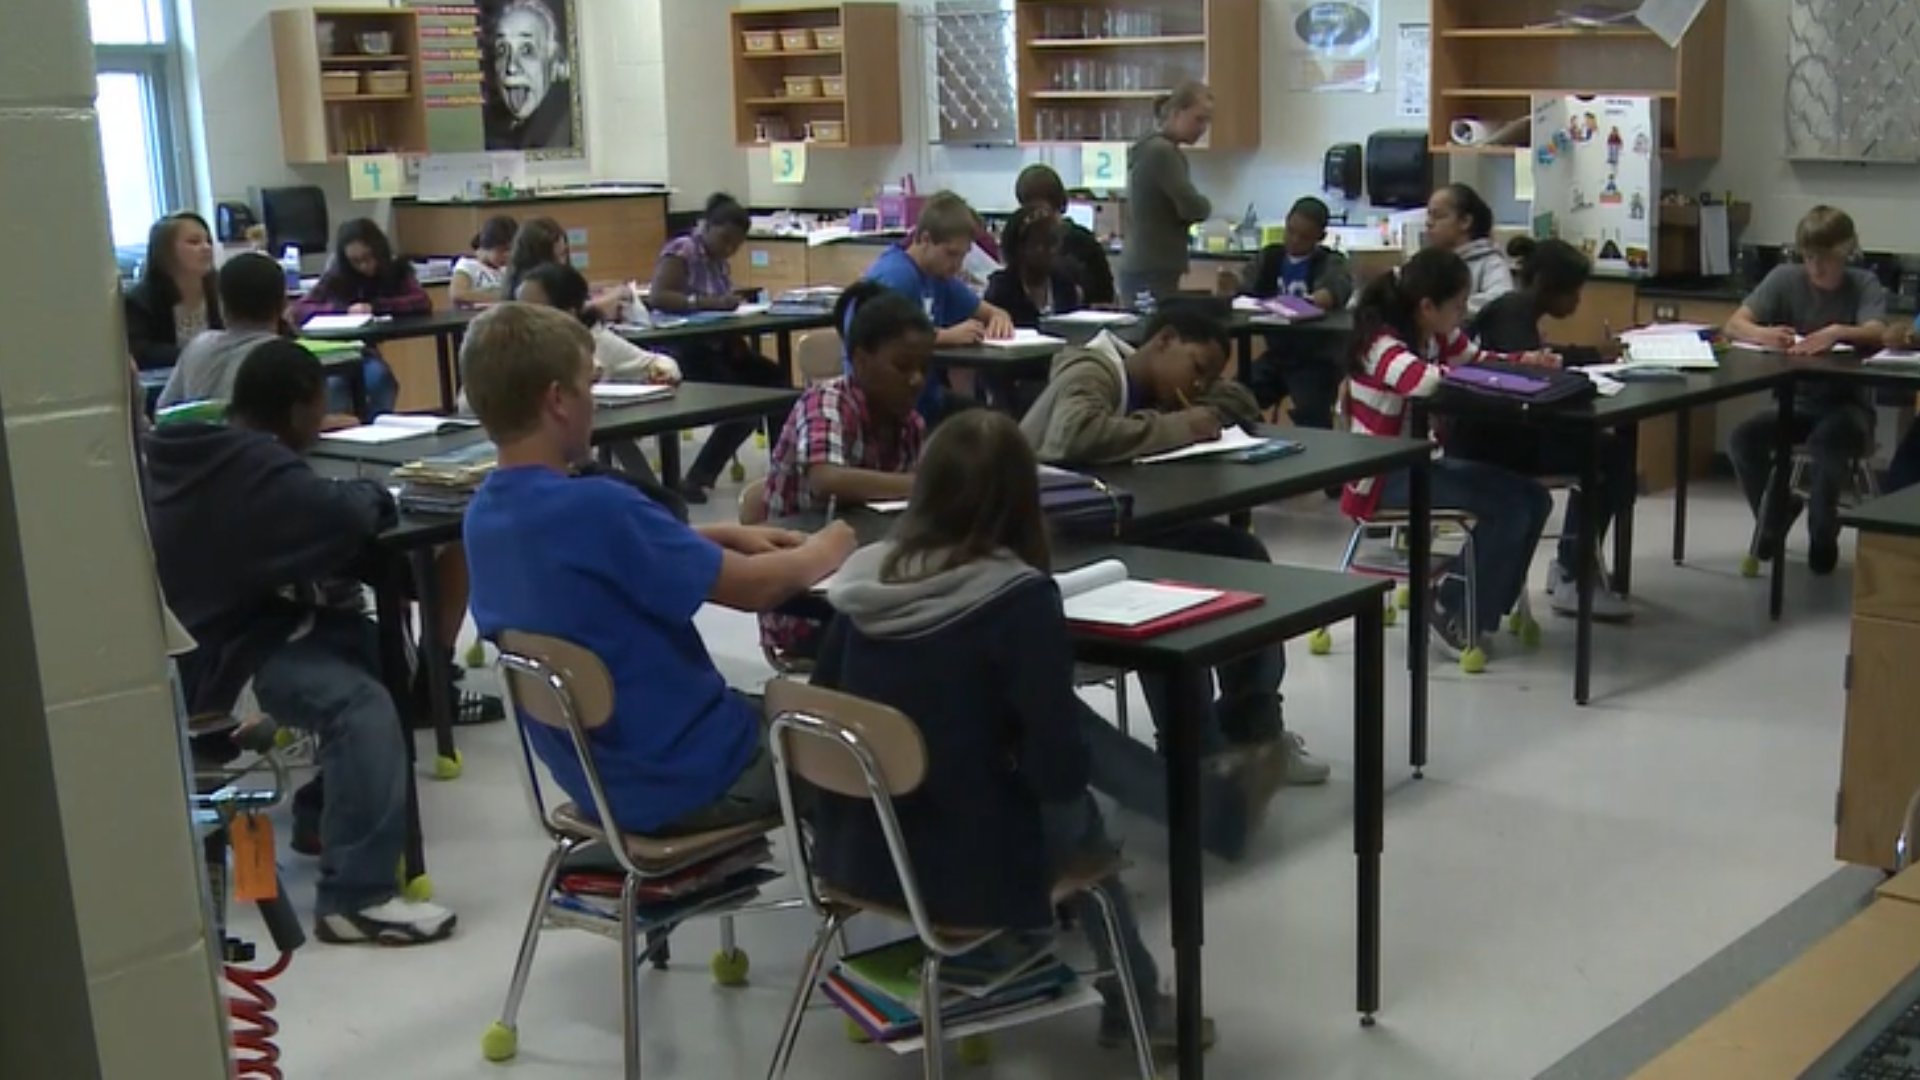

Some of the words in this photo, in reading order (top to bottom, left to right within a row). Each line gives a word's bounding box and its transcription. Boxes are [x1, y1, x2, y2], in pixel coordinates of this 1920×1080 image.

[364, 162, 381, 192] 4
[782, 149, 794, 177] 3
[1096, 151, 1111, 178] 2
